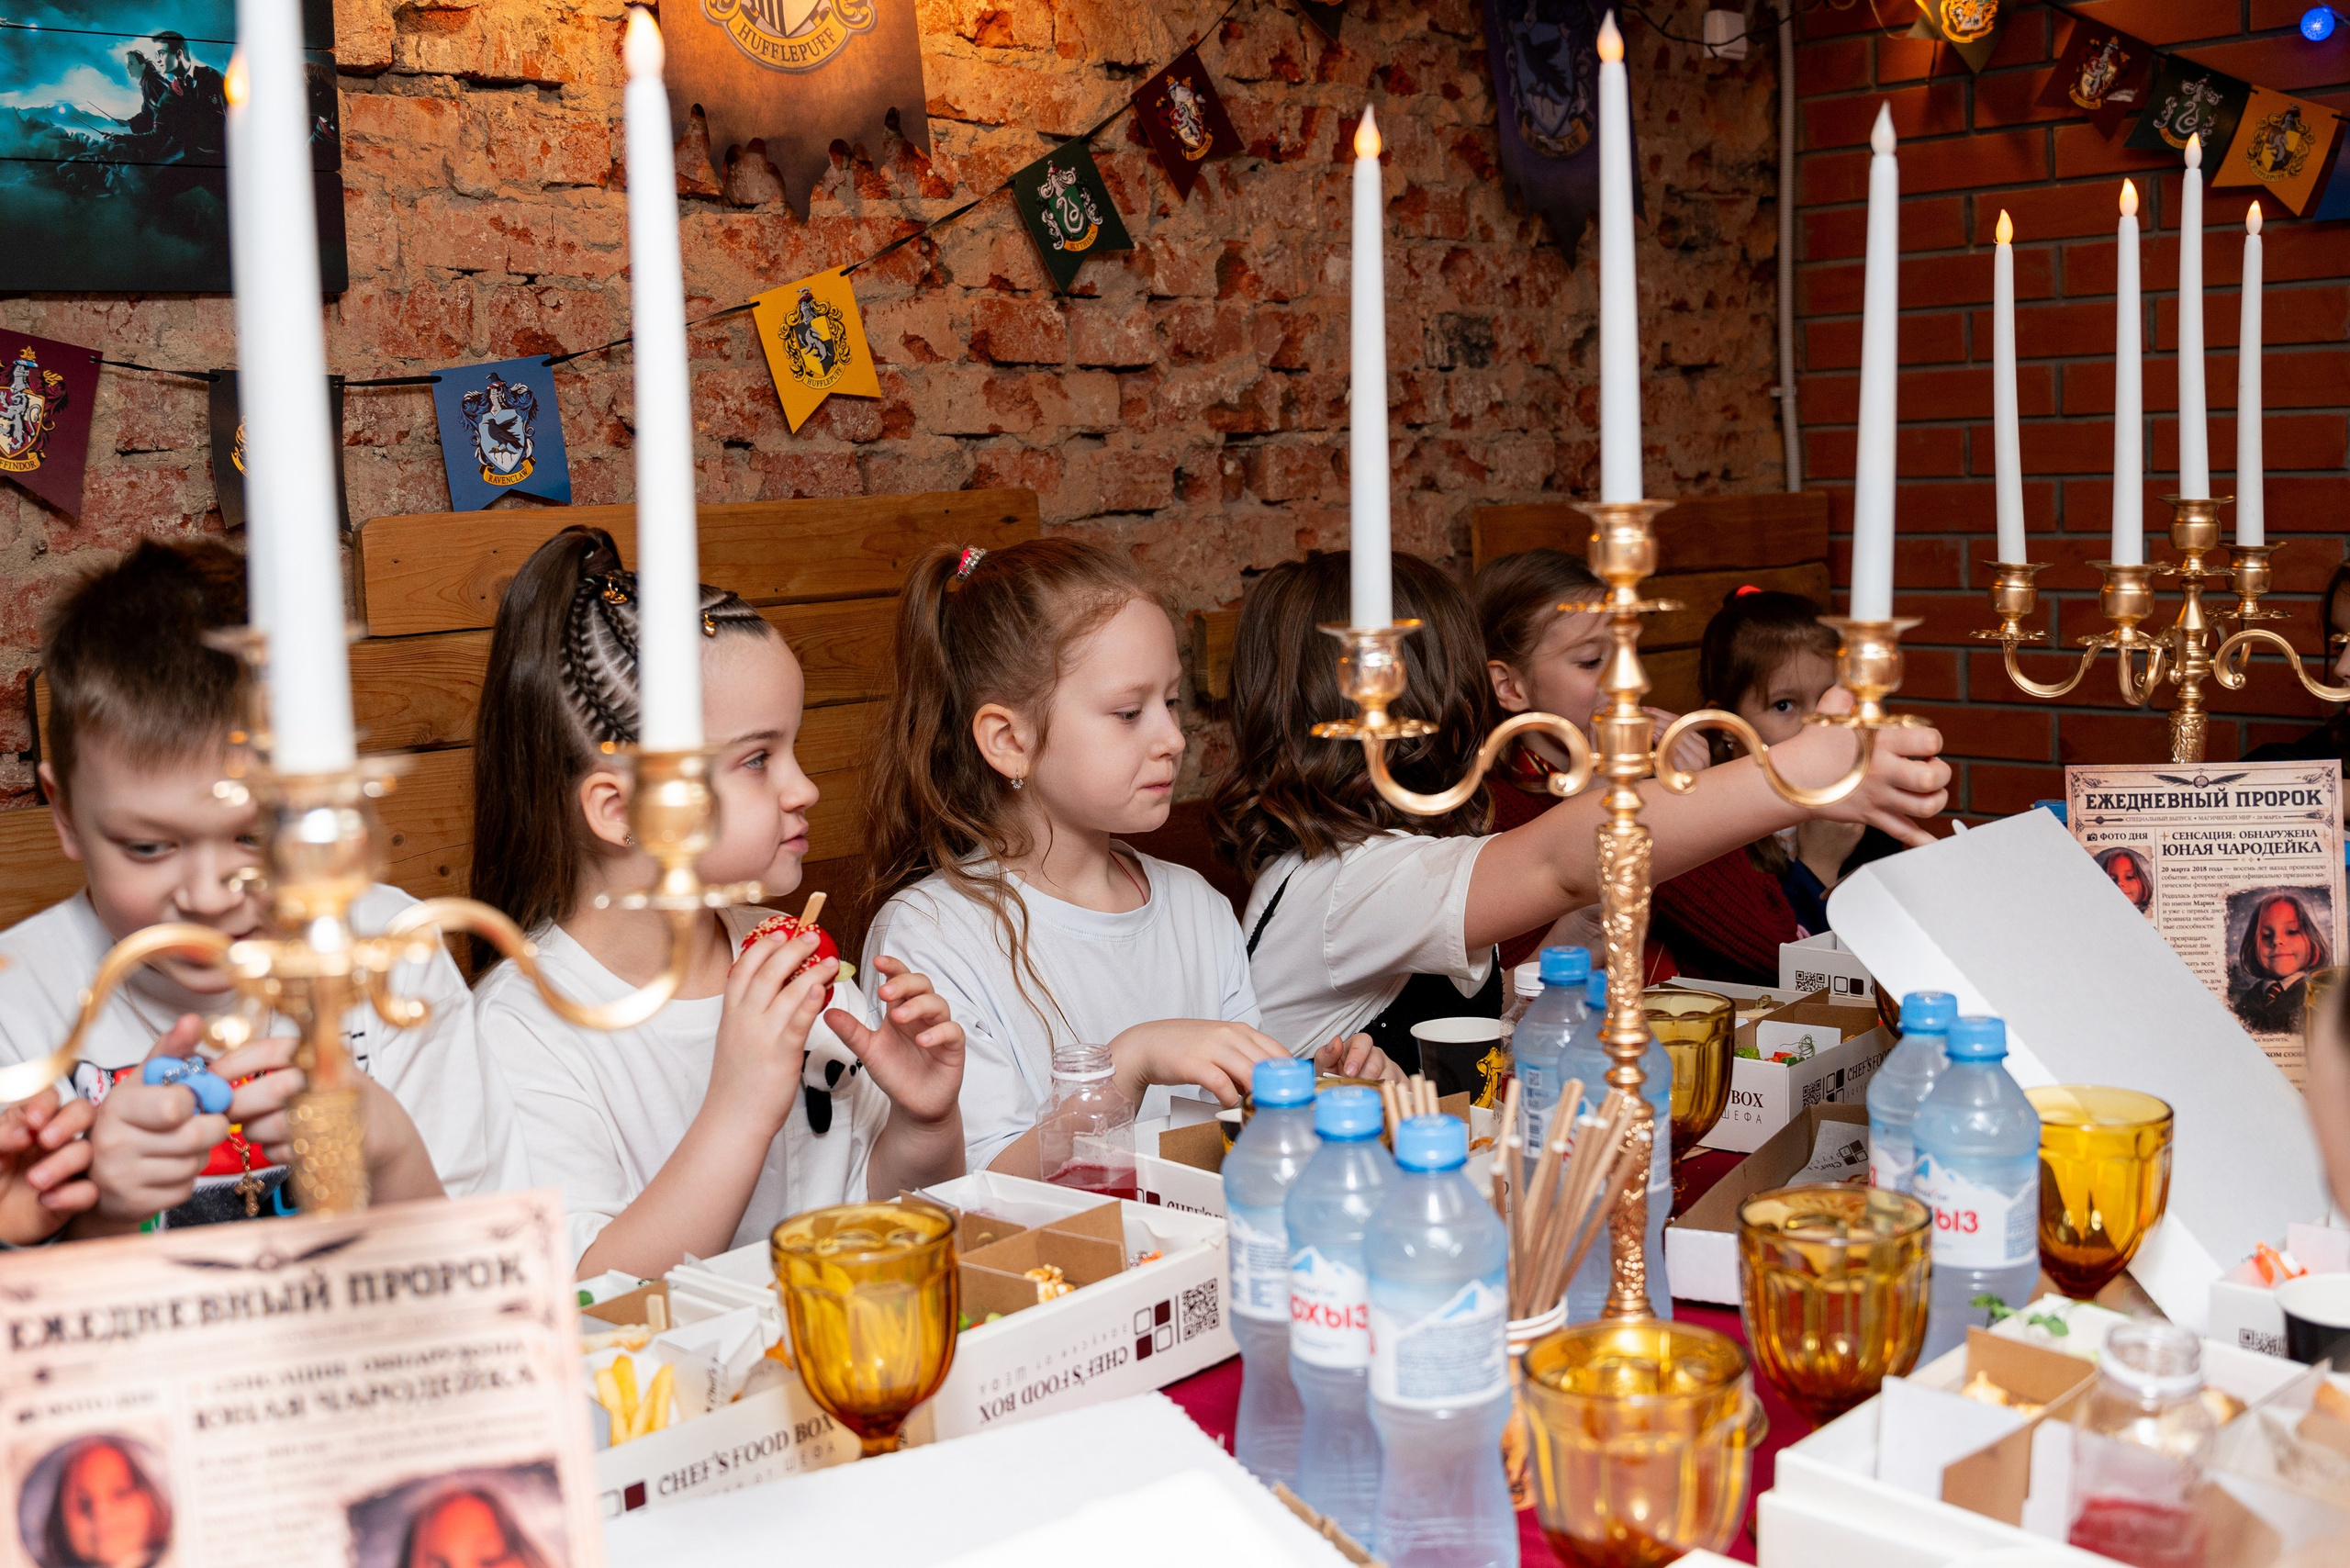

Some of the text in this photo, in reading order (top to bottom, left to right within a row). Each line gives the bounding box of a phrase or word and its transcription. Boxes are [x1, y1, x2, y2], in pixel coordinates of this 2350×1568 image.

[737, 22, 836, 62] HUFFLEPUFF
[807, 367, 843, 386] HUFFLEPUFF
[487, 468, 529, 485] RAVENCLAW
[2085, 788, 2323, 812] ЕЖЕДНЕВНЫЙ ПРОРОК
[2099, 832, 2148, 842] ФОТО ДНЯ
[2172, 829, 2318, 842] СЕНСАЦИЯ: ОБНАРУЖЕНА
[2162, 839, 2322, 857] ЮНАЯ ЧАРОДЕЙКА
[1847, 1056, 1872, 1081] CHEF'S
[1730, 1090, 1763, 1108] BOX
[1721, 1109, 1762, 1125] ШЕФА
[346, 1255, 528, 1305] ПРОРОК
[979, 1345, 1129, 1424] CHEF'S FOOD BOX
[657, 1450, 730, 1496] CHEF'S
[733, 1429, 789, 1468] FOOD
[793, 1411, 834, 1446] BOX
